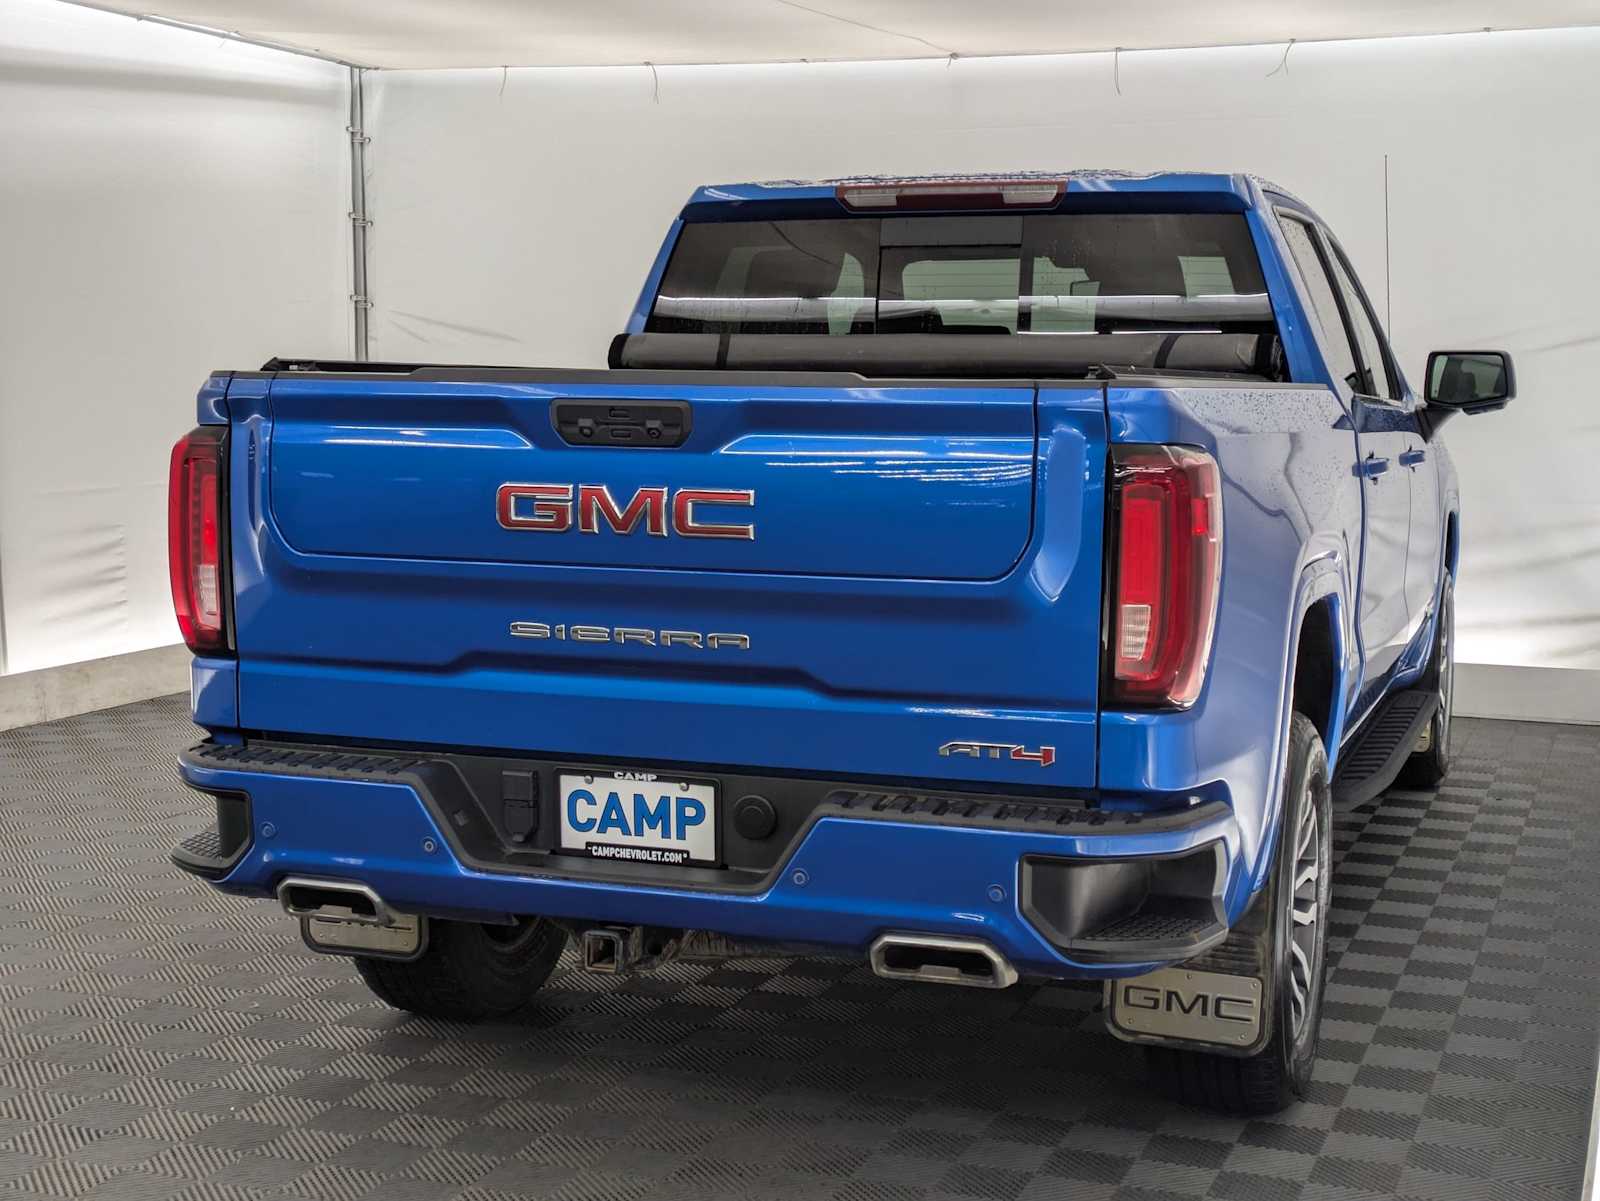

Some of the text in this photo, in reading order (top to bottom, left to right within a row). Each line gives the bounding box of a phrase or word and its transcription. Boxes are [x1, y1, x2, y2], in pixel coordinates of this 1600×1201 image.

[496, 482, 755, 540] GMC
[510, 622, 750, 649] SIERRA
[938, 741, 1056, 767] AT4
[613, 771, 658, 782] CAMP
[567, 789, 706, 841] CAMP
[592, 846, 683, 863] CAMPCHEVROLET.COM
[1124, 985, 1256, 1023] GMC
